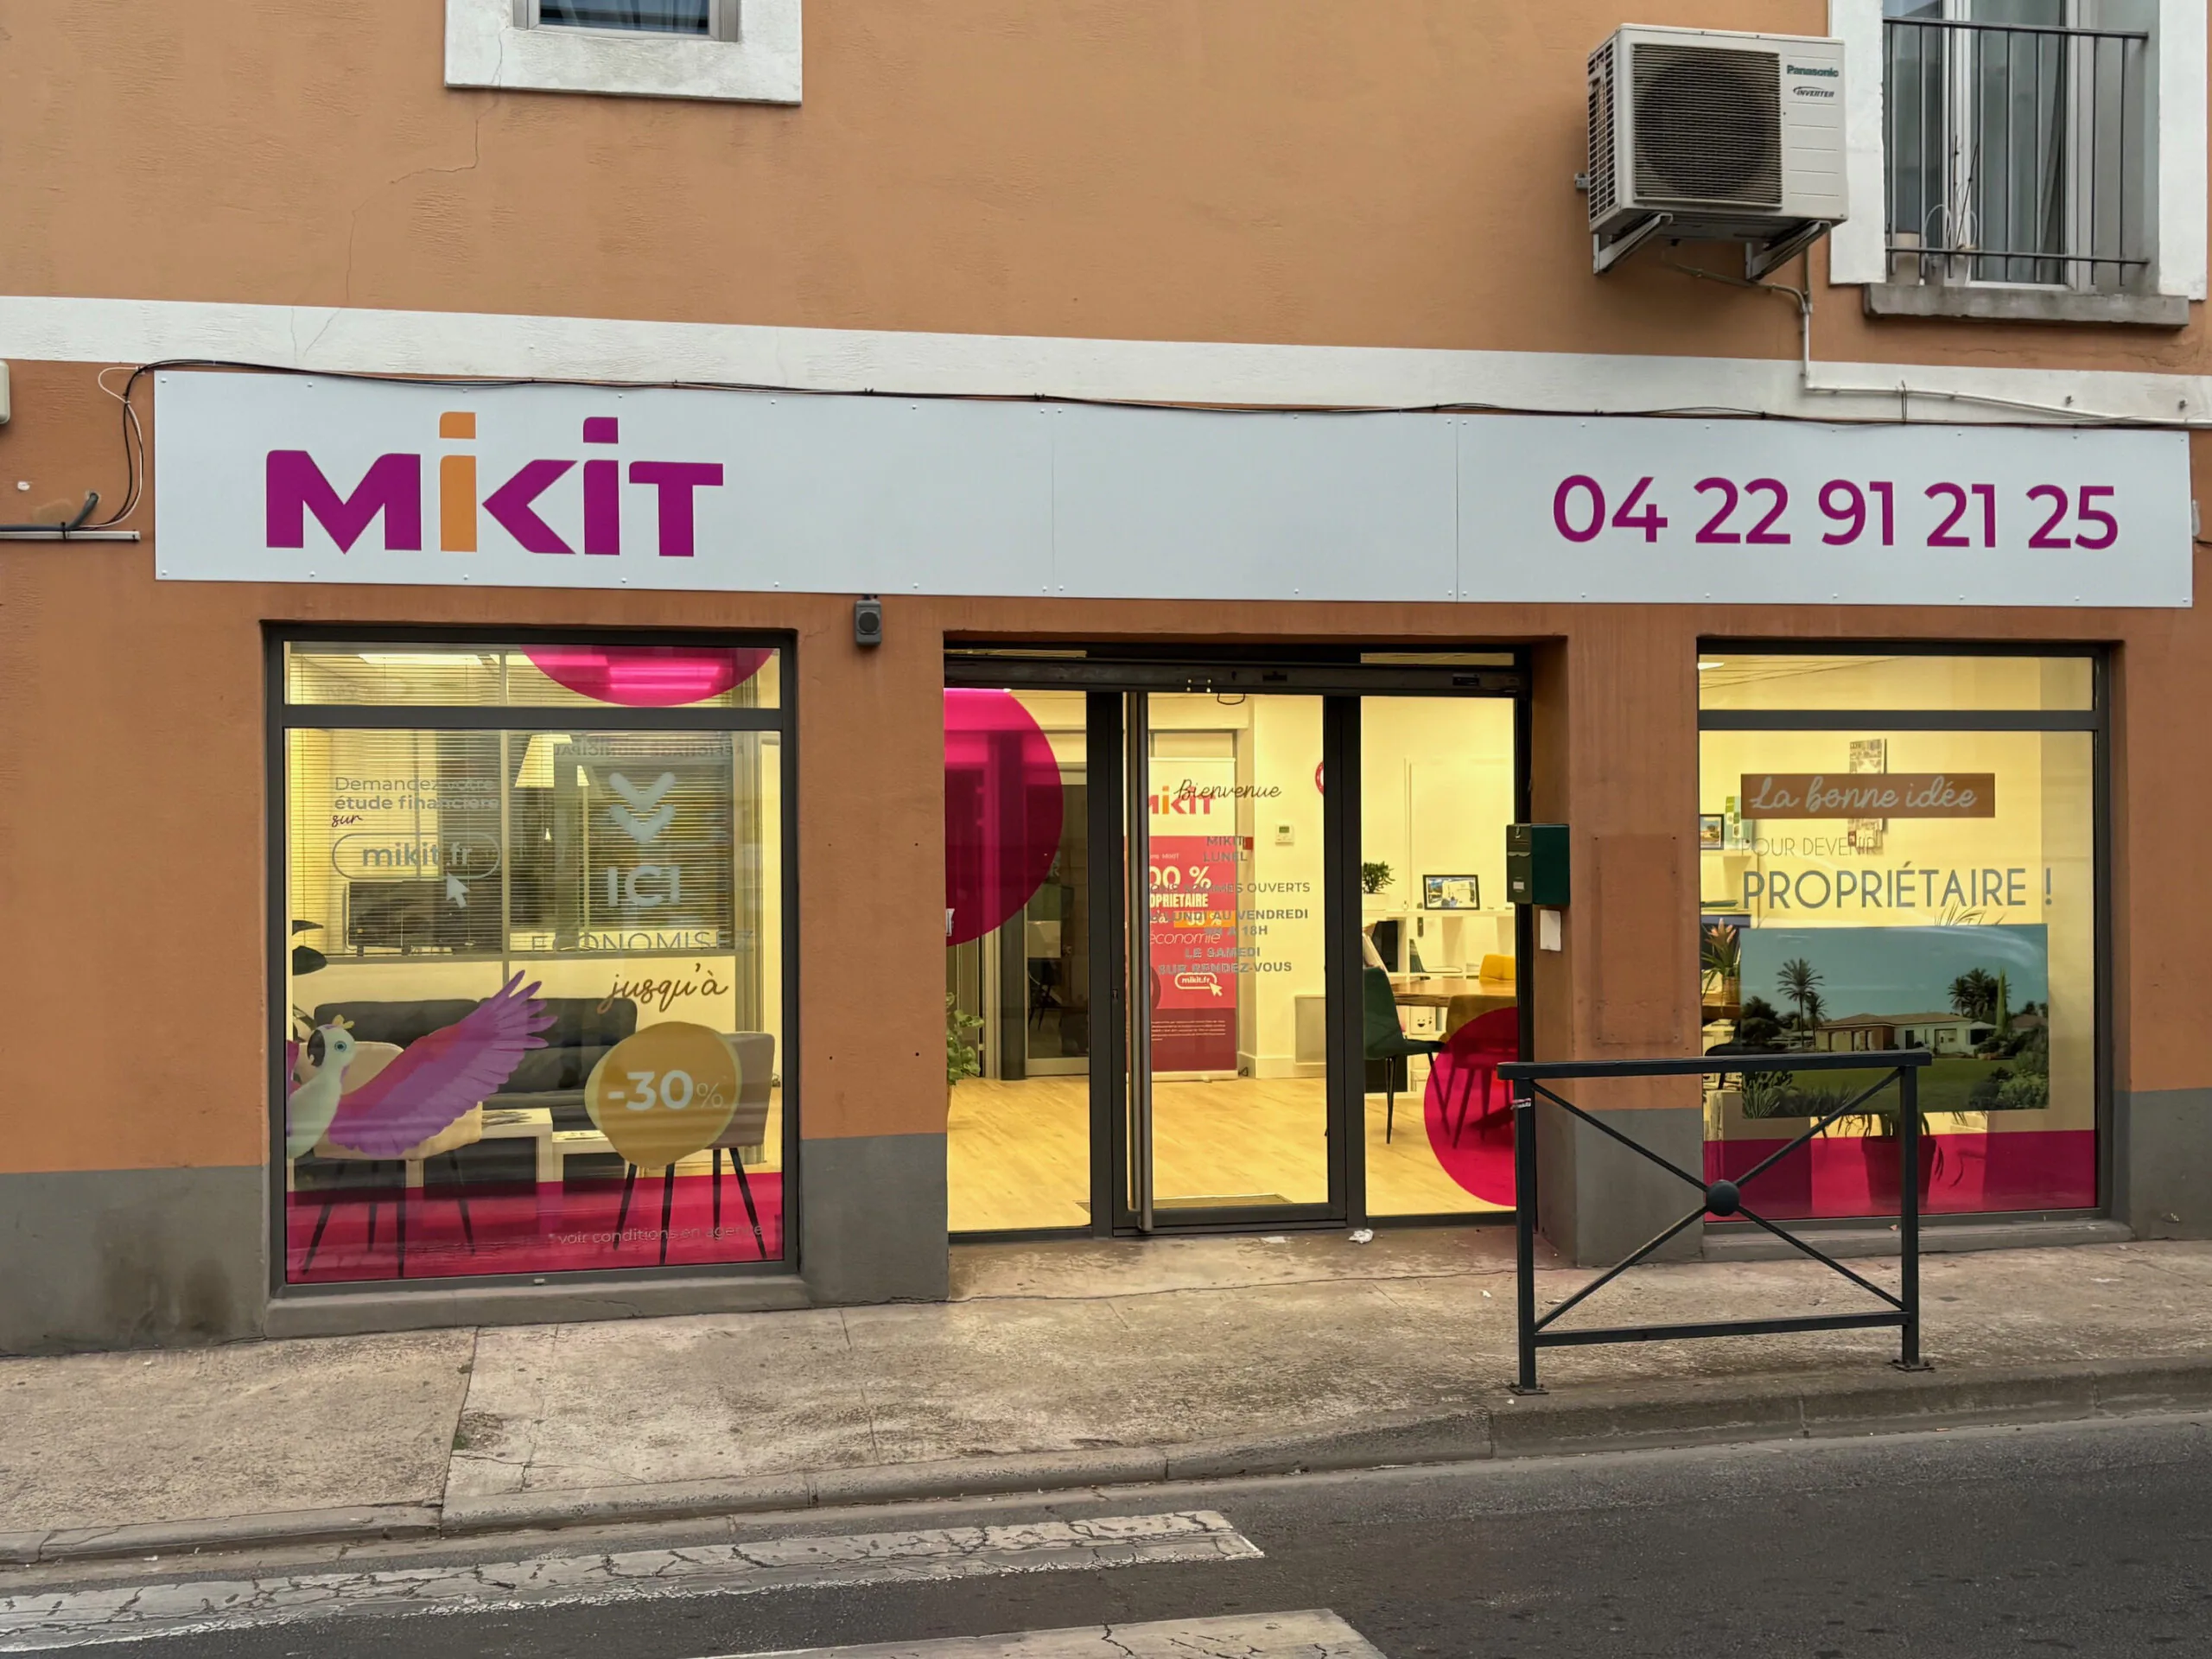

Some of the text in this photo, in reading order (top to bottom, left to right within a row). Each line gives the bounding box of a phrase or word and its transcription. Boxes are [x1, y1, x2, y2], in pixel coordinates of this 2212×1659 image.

[1786, 64, 1840, 78] Panasonic
[1794, 87, 1834, 98] INVERTER
[1553, 474, 2119, 550] 04 22 91 21 25
[334, 777, 437, 791] Demandez
[1173, 779, 1282, 800] Bienvenue
[1750, 775, 1977, 812] La bonne idée
[334, 795, 392, 810] étude
[332, 814, 363, 827] sur
[1206, 836, 1245, 847] MIKIT
[1742, 836, 1876, 856] POUR DEVENIR
[363, 842, 474, 866] mikit.fr
[1203, 851, 1248, 862] LUNEL
[607, 865, 681, 907] ICI
[1247, 882, 1311, 893] OUVERTS
[1743, 861, 2052, 909] PROPRIÉTAIRE !
[1236, 909, 1308, 919] VENDREDI
[1242, 925, 1268, 935] 18H
[1185, 947, 1261, 958] LE SAMEDI
[1192, 961, 1293, 974] RENDEZ-VOUS
[596, 963, 729, 1014] jusqu'à
[593, 1226, 677, 1244] conditions
